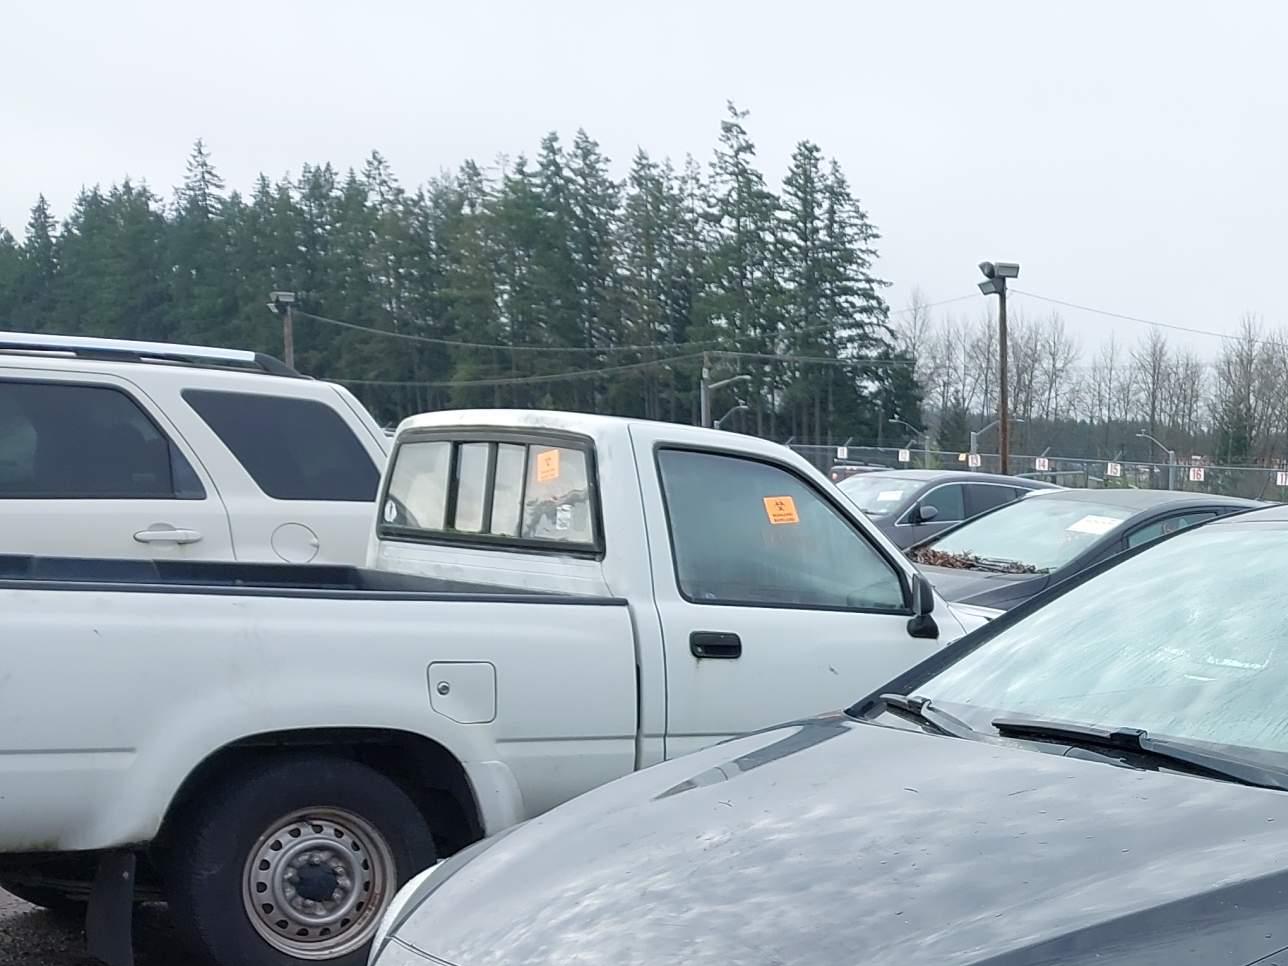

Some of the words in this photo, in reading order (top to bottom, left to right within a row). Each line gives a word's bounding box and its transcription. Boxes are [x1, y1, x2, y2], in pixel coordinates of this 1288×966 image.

[1038, 459, 1047, 469] 14
[1109, 463, 1119, 475] 15
[1192, 469, 1202, 480] 16
